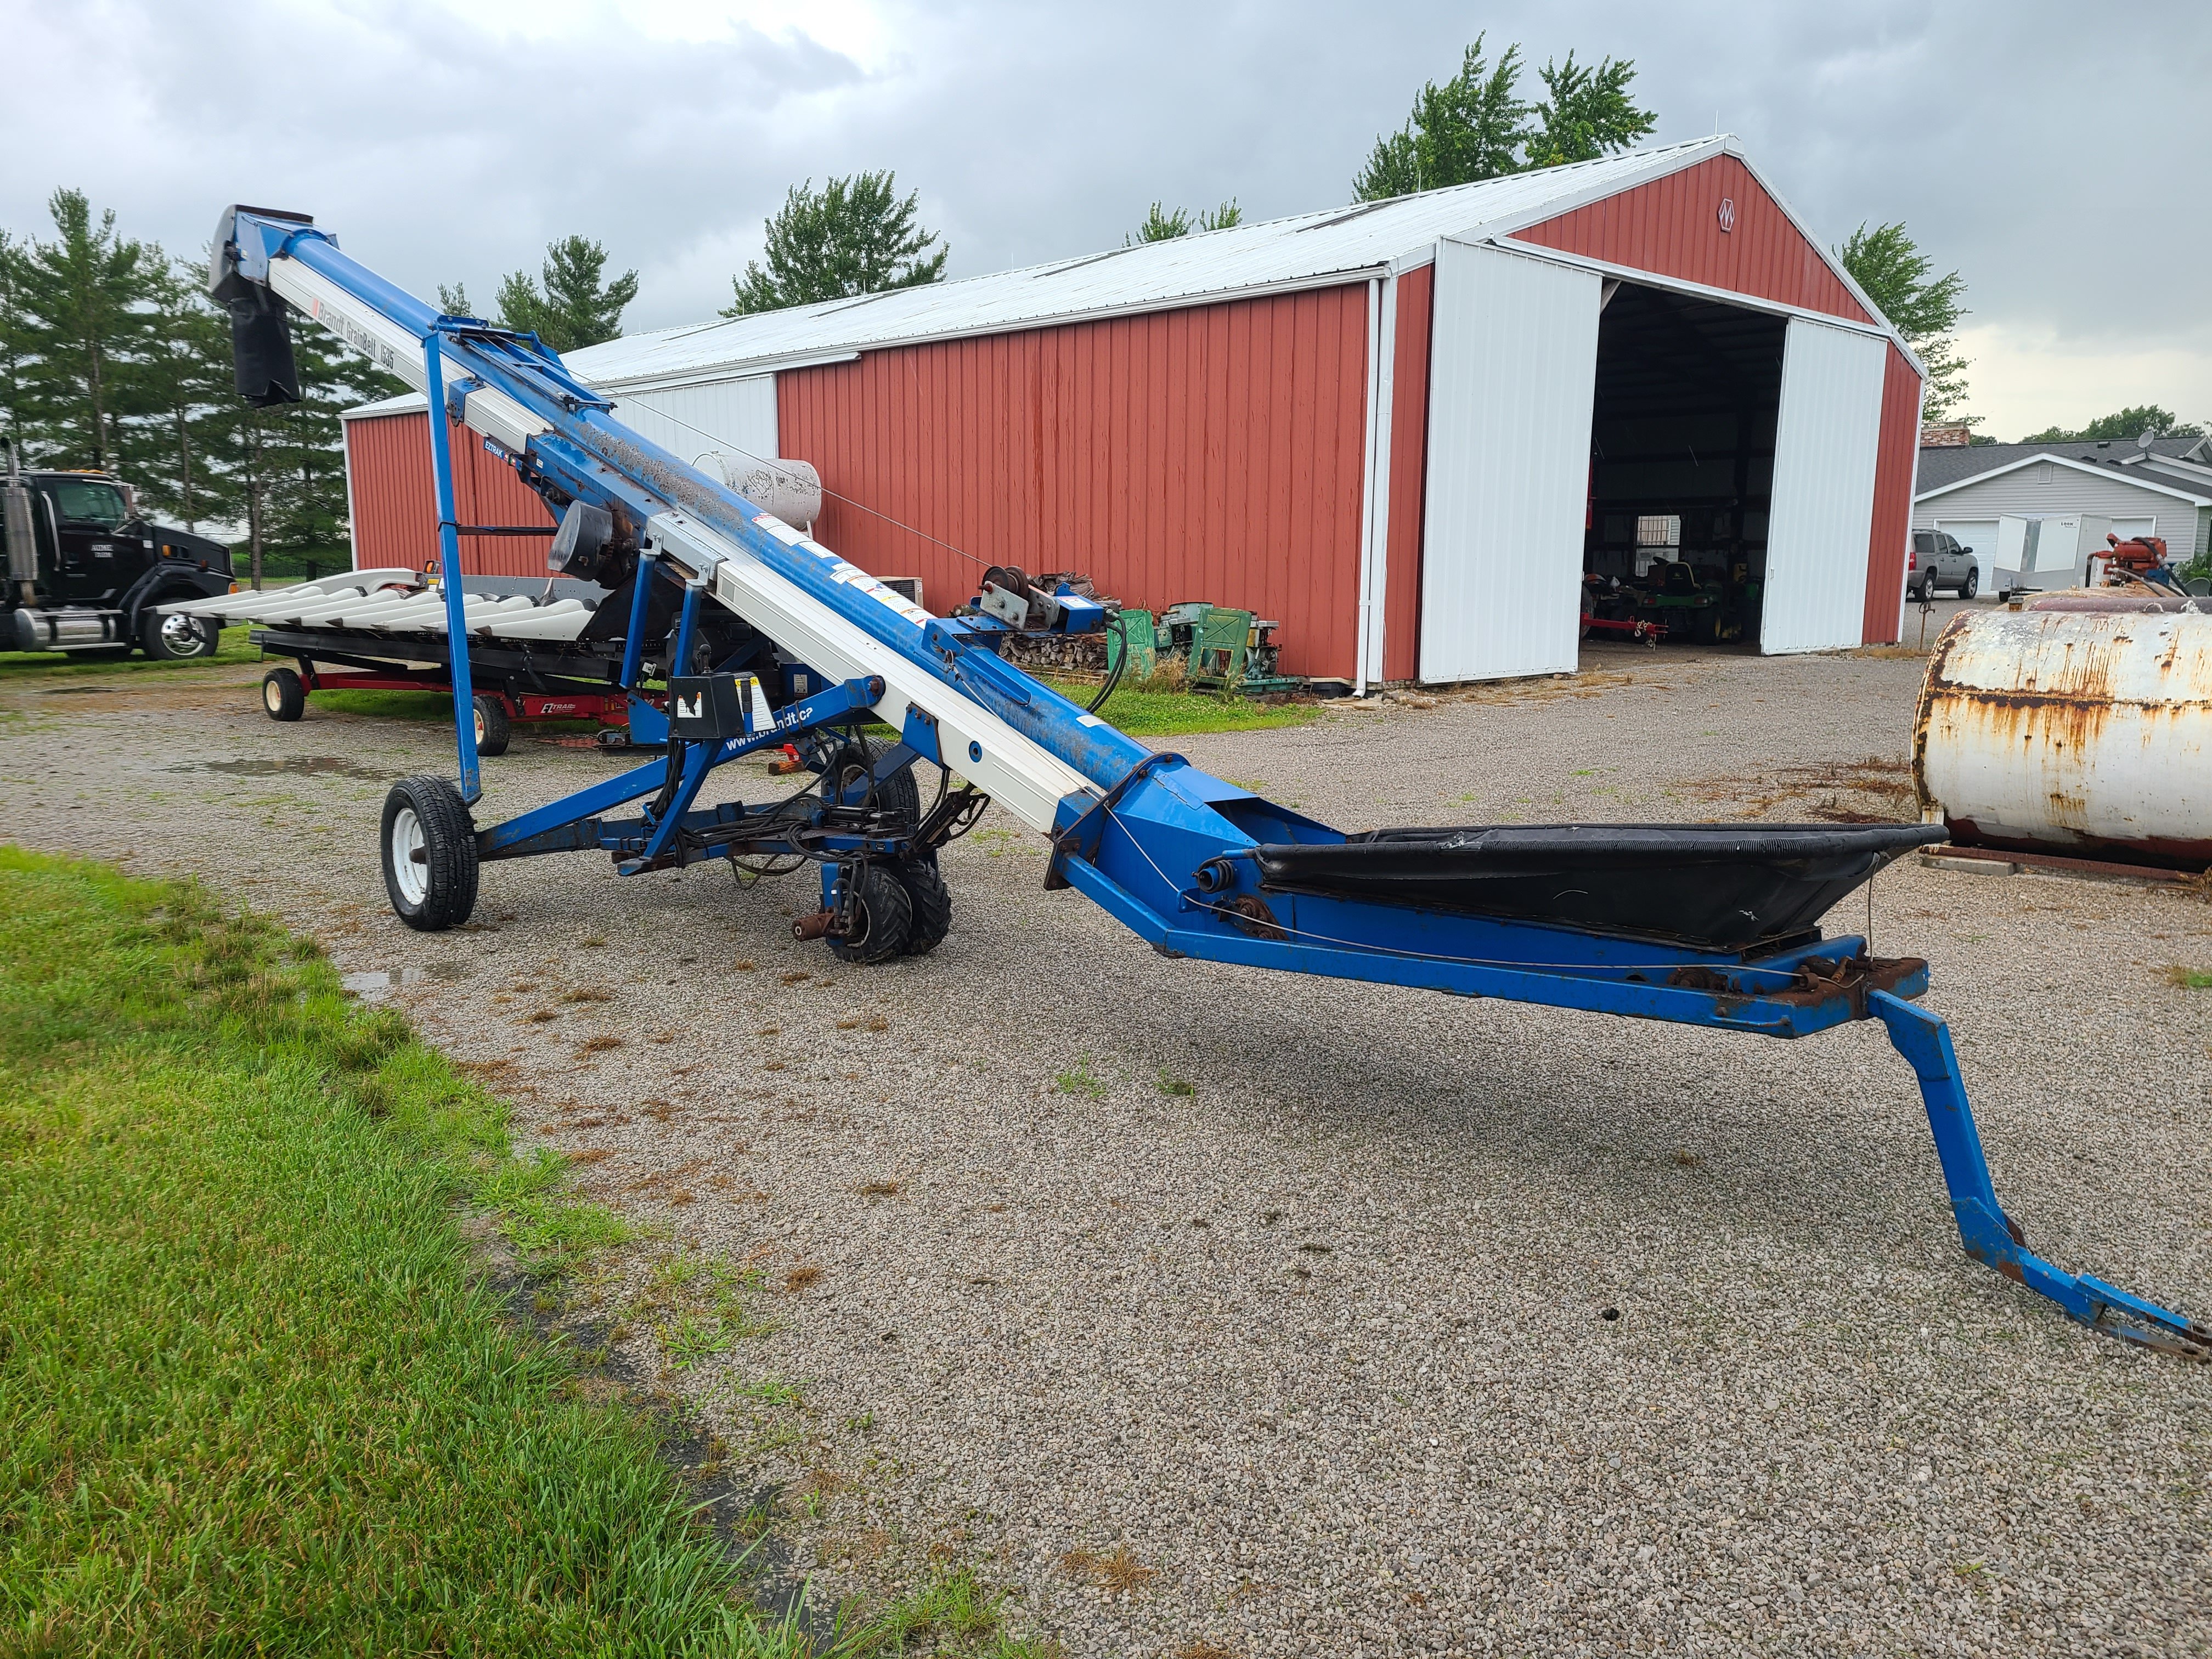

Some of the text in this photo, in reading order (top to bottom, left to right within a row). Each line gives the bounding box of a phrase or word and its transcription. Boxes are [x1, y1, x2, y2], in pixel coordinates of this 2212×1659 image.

[318, 301, 394, 369] Brandt GrainBelt 1535
[484, 441, 503, 458] EZTRAK
